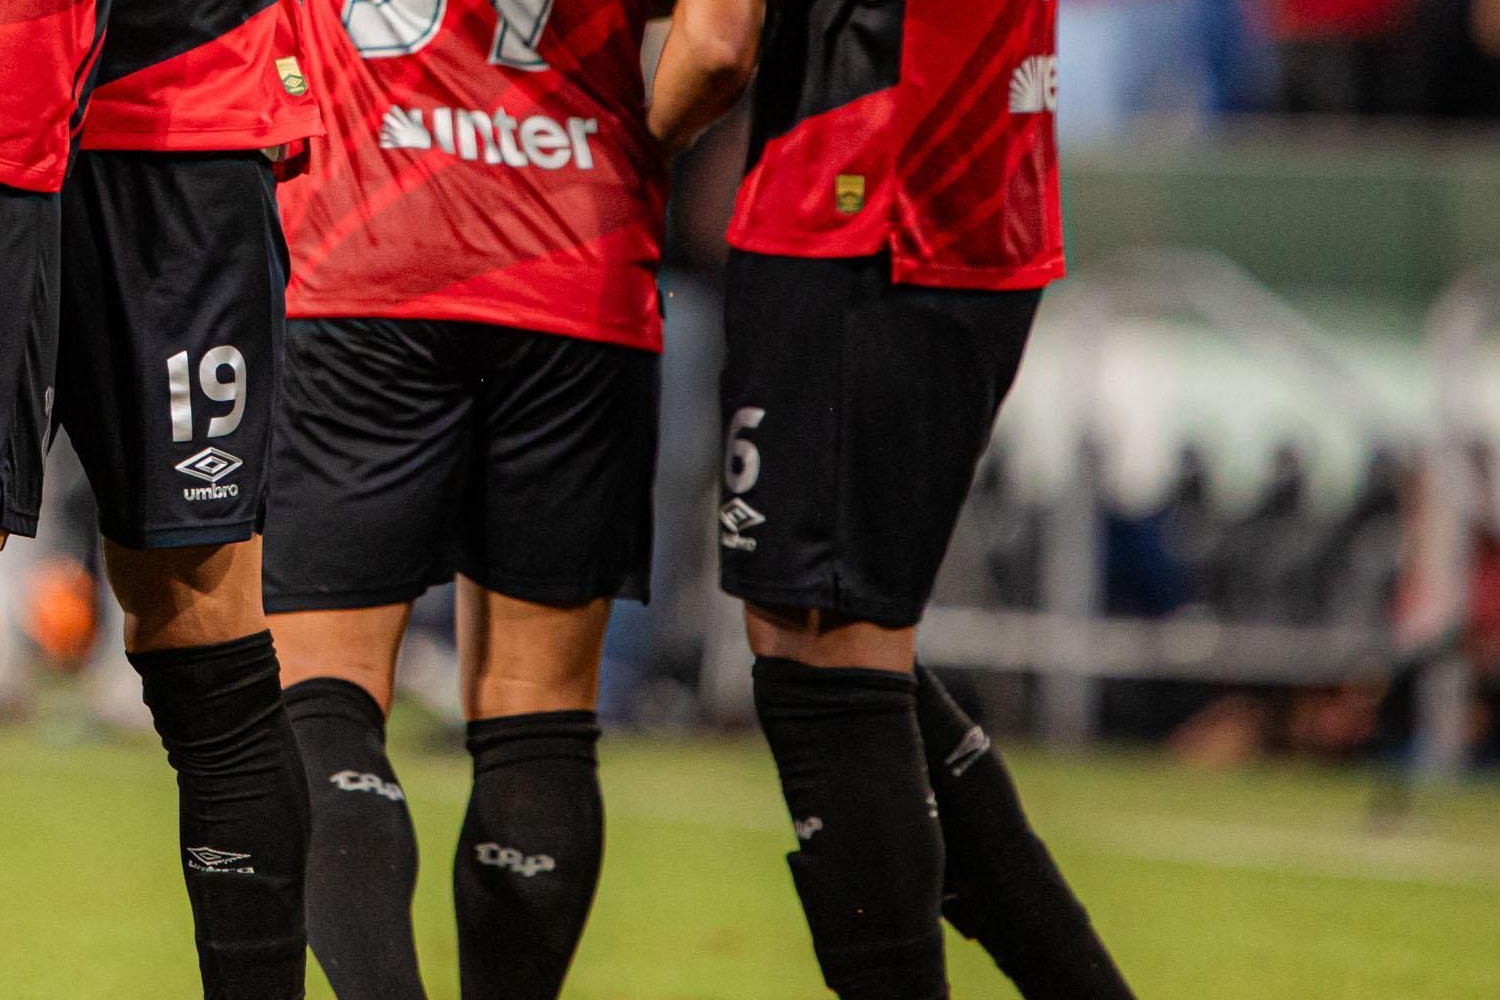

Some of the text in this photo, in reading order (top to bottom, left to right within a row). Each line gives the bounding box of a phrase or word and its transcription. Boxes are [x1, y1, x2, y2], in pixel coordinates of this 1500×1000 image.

[433, 105, 598, 170] inter
[167, 345, 247, 442] 19
[725, 406, 766, 494] 6
[184, 483, 239, 501] umbro
